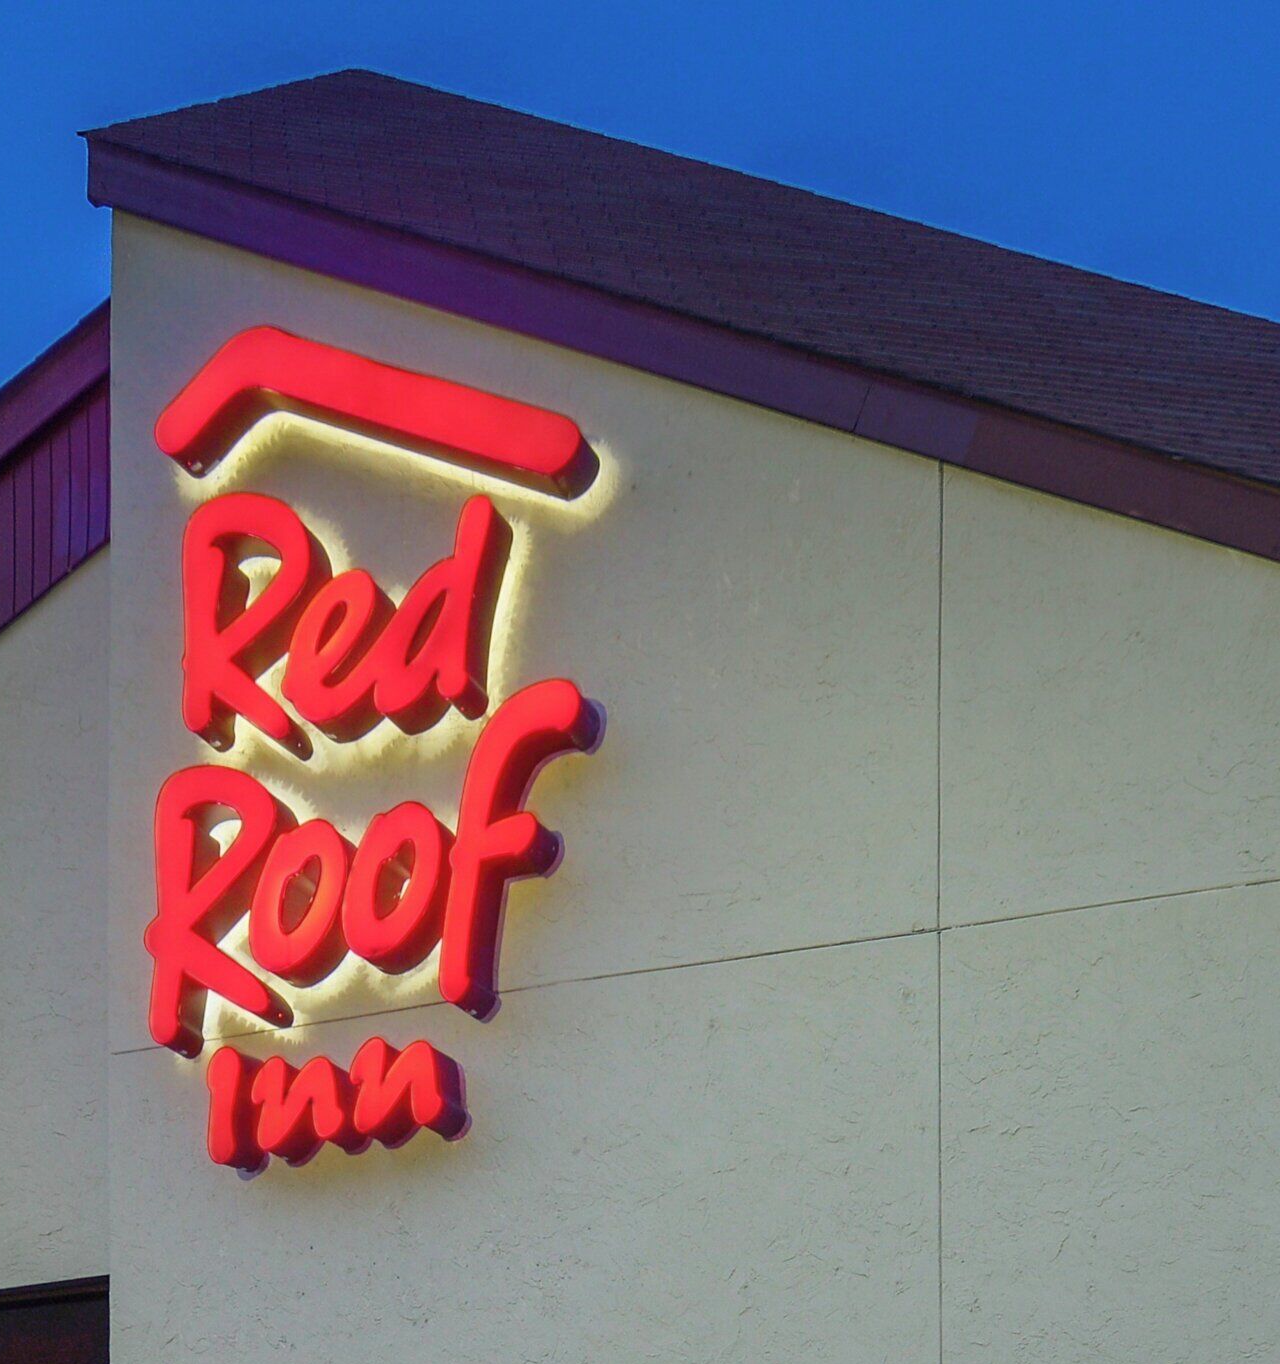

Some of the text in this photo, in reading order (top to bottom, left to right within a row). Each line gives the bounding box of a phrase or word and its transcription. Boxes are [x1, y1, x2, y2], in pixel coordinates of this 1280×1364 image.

[181, 490, 502, 752] Red
[143, 677, 594, 1054] Roof
[205, 1036, 462, 1171] Inn
